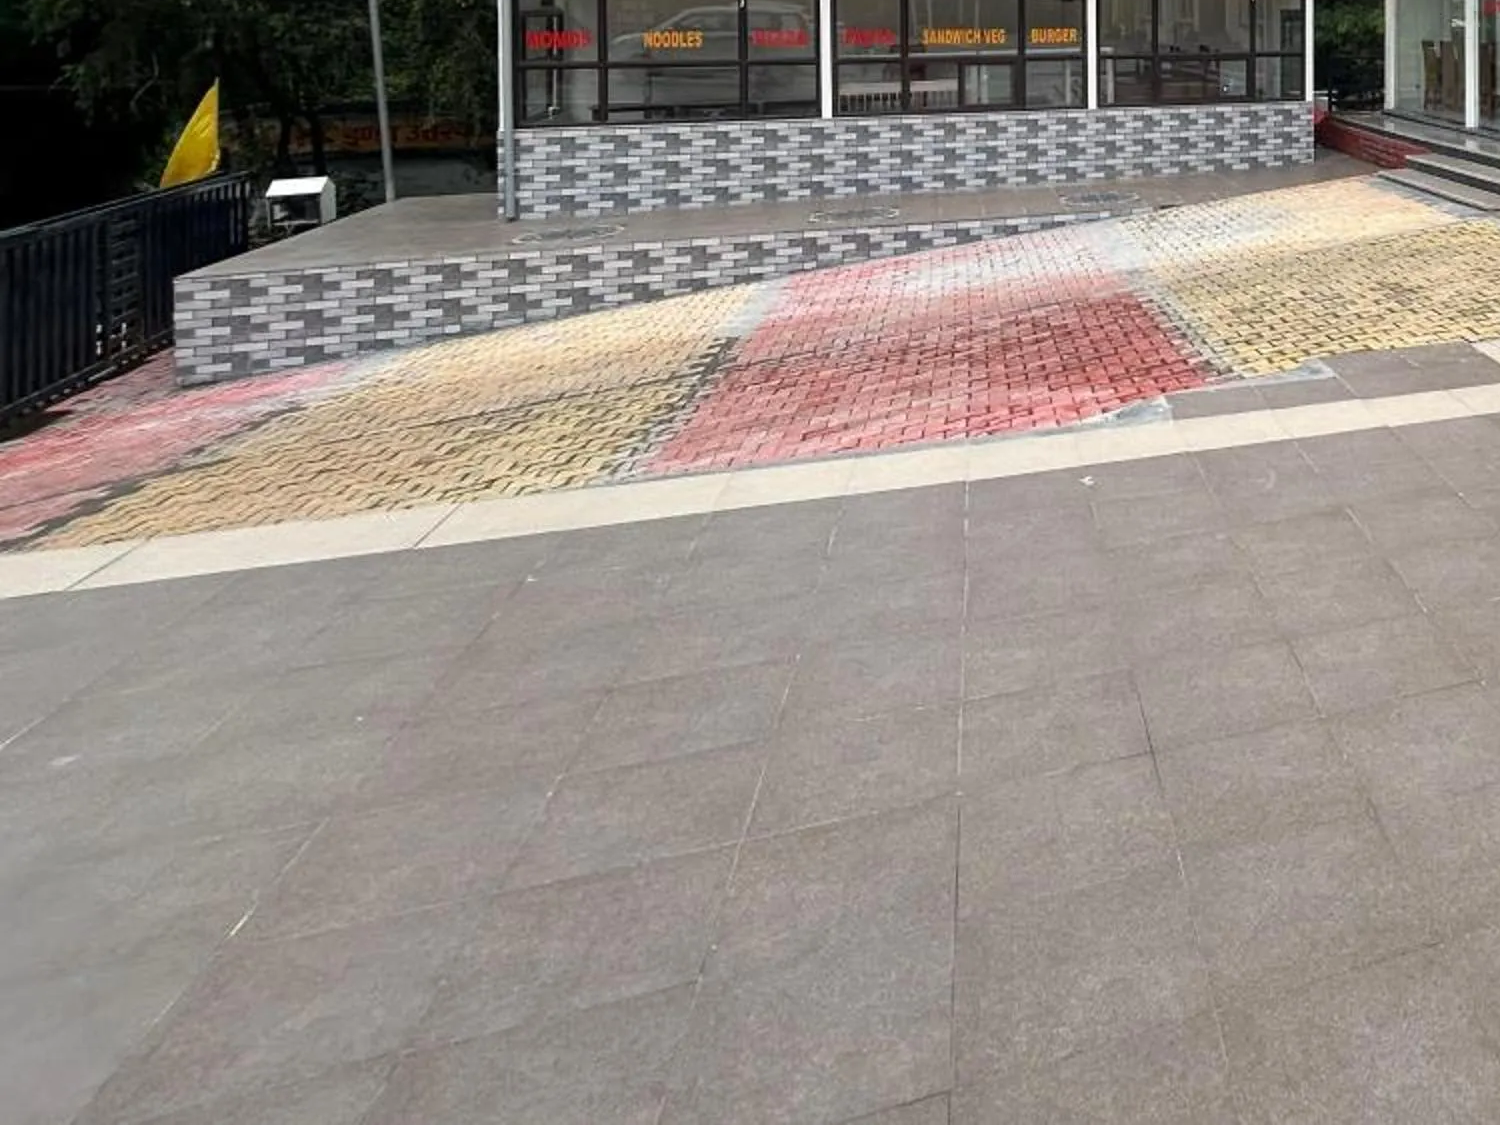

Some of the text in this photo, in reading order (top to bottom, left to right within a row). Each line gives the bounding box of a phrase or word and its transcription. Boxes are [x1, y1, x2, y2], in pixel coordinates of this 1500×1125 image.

[643, 31, 703, 48] NOODLES
[922, 27, 1007, 45] SANDWICH VEG
[1030, 28, 1078, 44] BURGER
